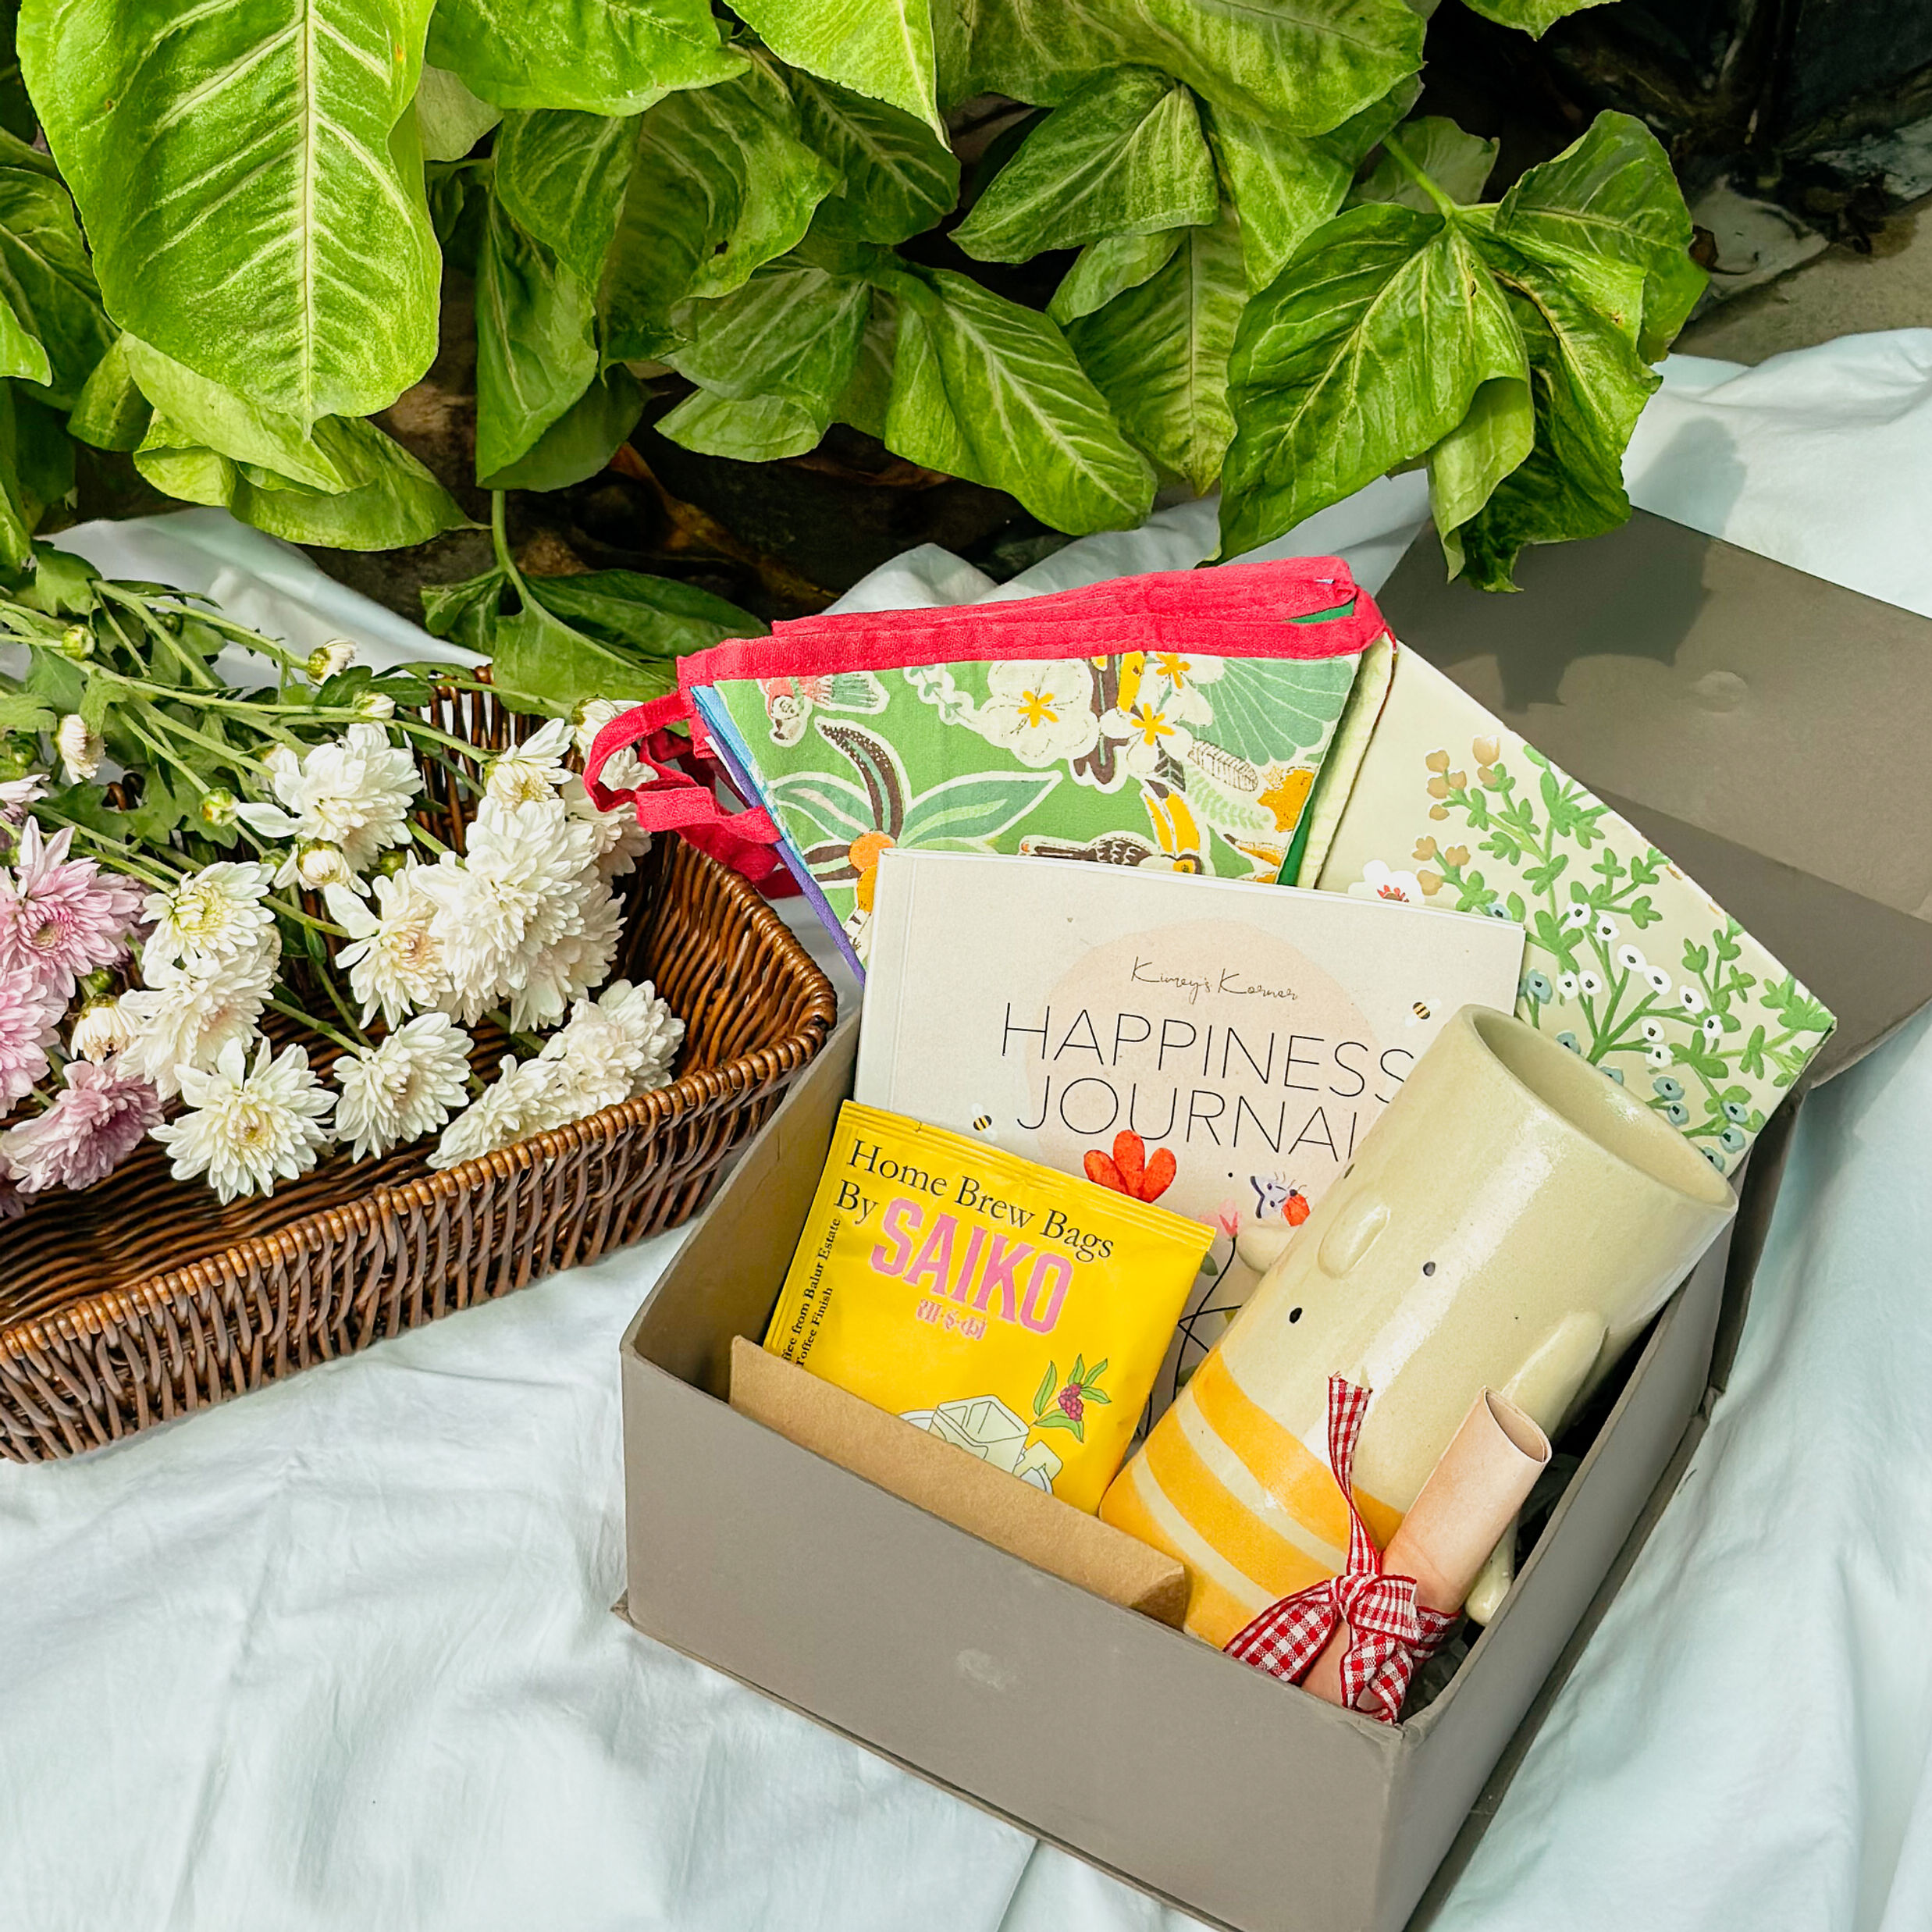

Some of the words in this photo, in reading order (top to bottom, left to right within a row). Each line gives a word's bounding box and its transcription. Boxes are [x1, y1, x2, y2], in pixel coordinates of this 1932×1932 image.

[1218, 968, 1298, 1000] Korner
[1002, 1002, 1415, 1105] HAPPINESS
[847, 1138, 948, 1197] Home
[955, 1176, 1036, 1229] Brew
[1040, 1208, 1115, 1263] Bags
[792, 1304, 809, 1336] from
[803, 1262, 824, 1300] Balur
[818, 1219, 841, 1261] Estate
[811, 1287, 833, 1327] Finish
[834, 1179, 880, 1225] By
[870, 1197, 1074, 1333] SAIKO
